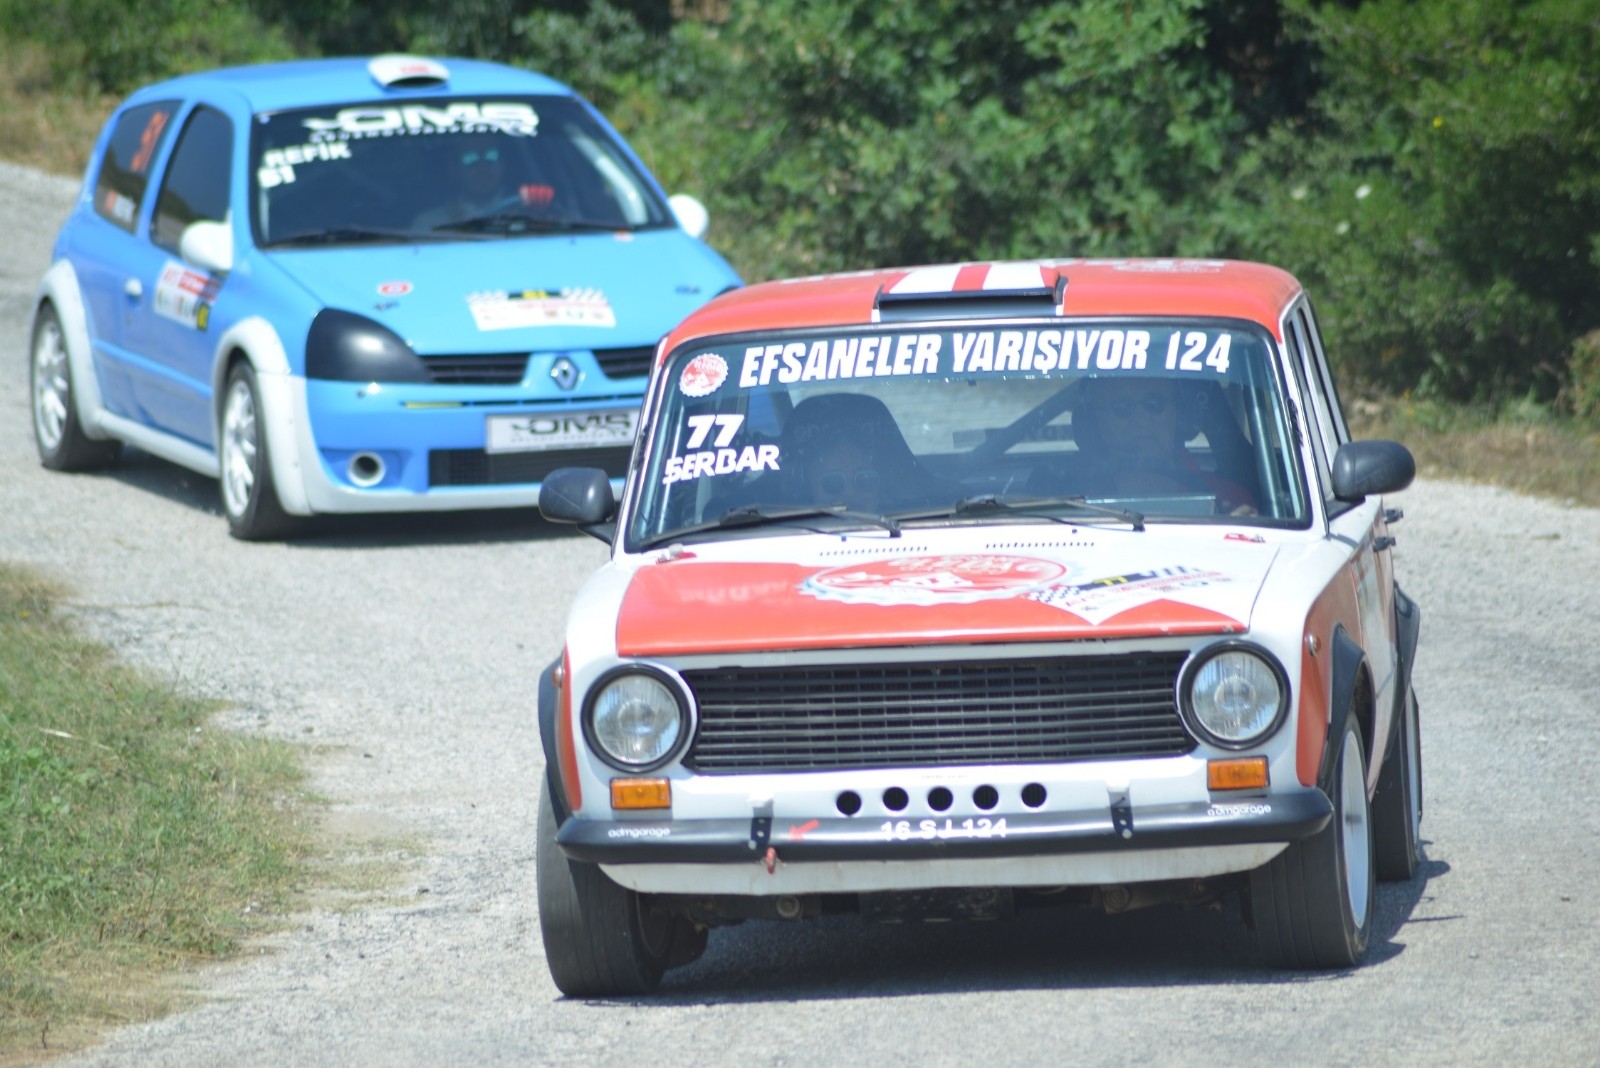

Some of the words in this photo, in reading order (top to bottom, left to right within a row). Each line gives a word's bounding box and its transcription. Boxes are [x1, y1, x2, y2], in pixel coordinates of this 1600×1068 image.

[739, 333, 942, 388] EFSANELER
[952, 329, 1150, 375] YARIŞIYOR
[1165, 330, 1232, 374] 124
[686, 414, 745, 449] 77
[880, 820, 912, 841] 16
[961, 817, 1007, 839] 124
